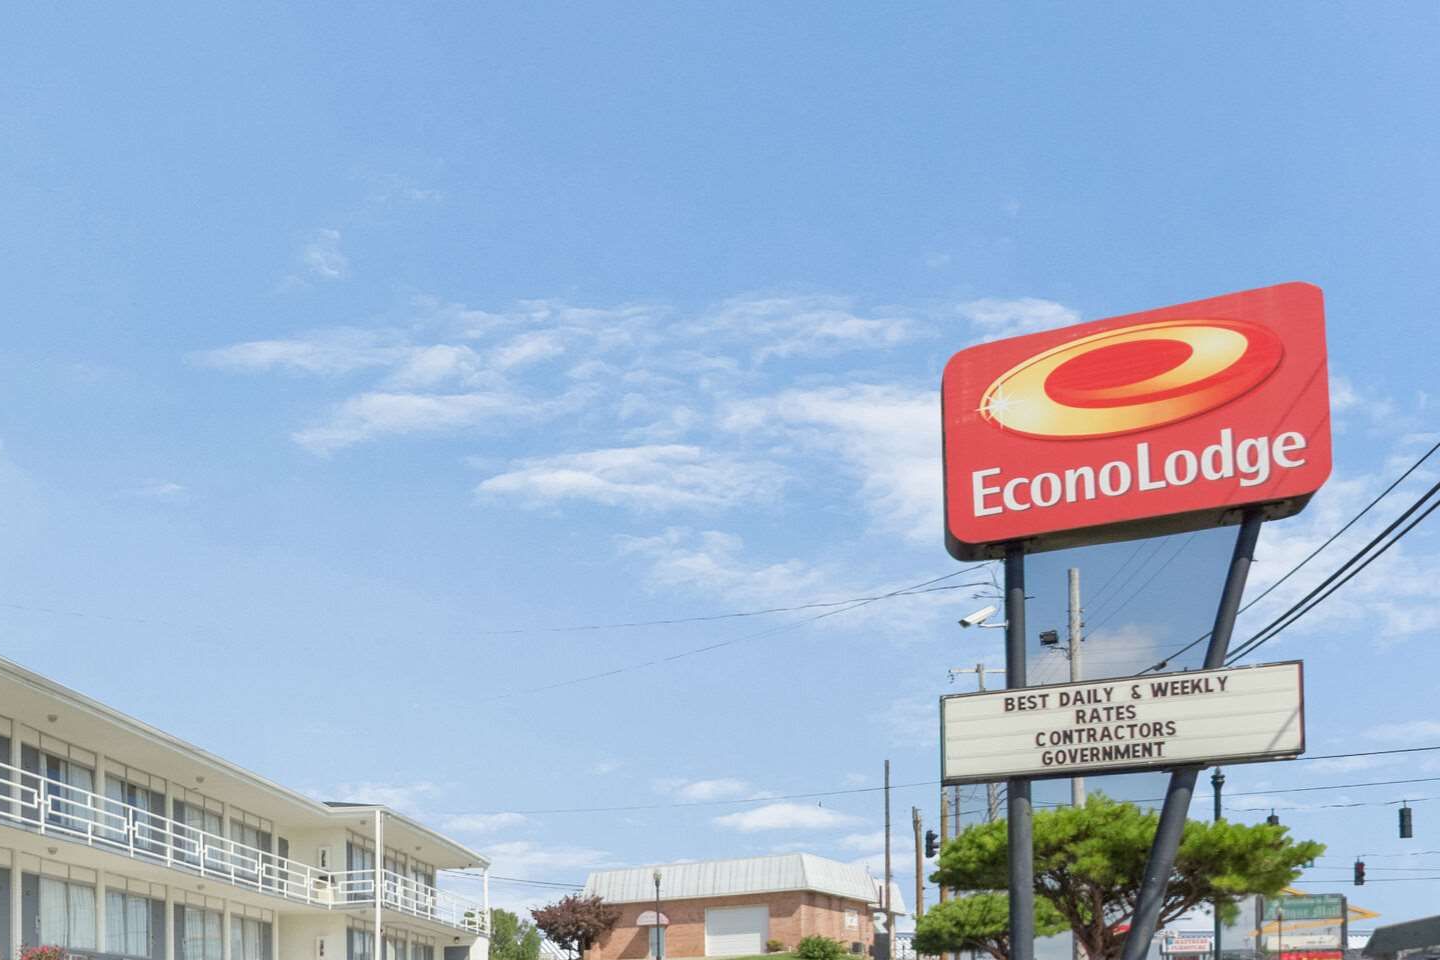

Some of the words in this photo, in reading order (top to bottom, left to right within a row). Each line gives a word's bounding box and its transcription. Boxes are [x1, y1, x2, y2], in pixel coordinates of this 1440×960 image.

[971, 428, 1307, 518] EconoLodge
[1003, 693, 1050, 712] BEST
[1058, 687, 1114, 707] DAILY
[1130, 684, 1142, 700] &
[1150, 675, 1228, 698] WEEKLY
[1075, 704, 1137, 725] RATES
[1035, 720, 1177, 747] CONTRACTORS
[1041, 741, 1166, 766] GOVERNMENT
